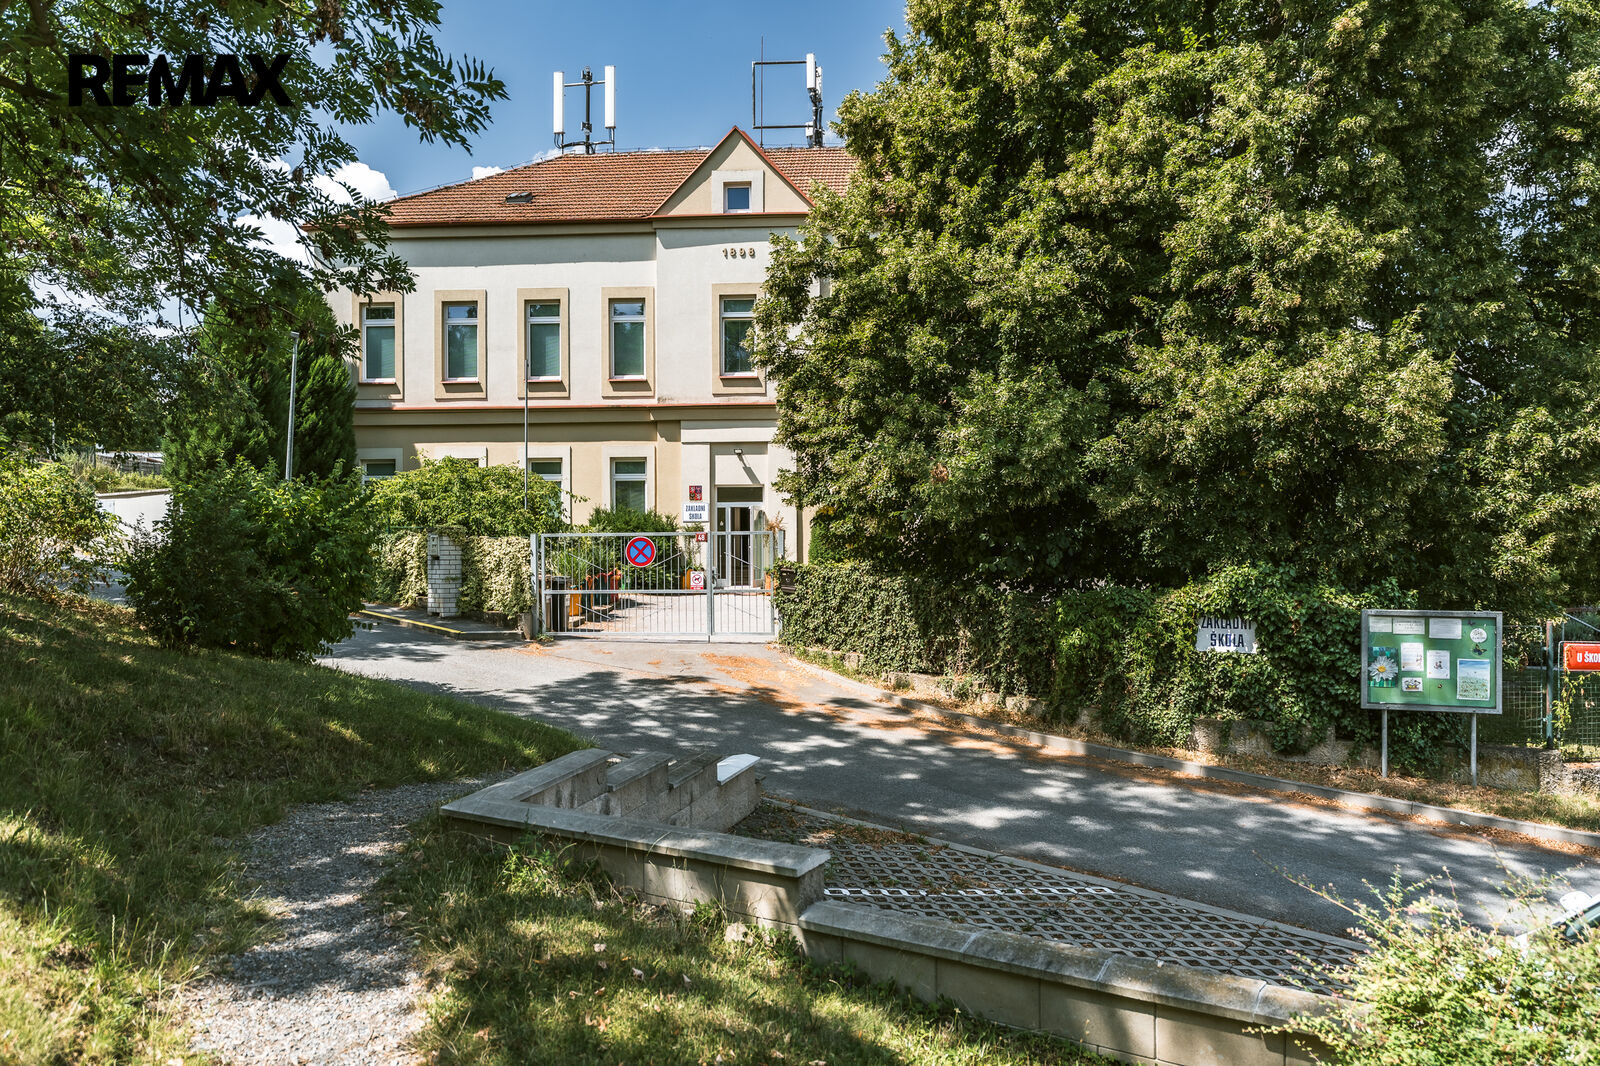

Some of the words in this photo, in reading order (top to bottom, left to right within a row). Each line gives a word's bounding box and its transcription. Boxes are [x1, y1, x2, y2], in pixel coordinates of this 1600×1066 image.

[722, 247, 755, 258] 1898
[1210, 631, 1244, 647] ŠKOLA
[1577, 652, 1583, 663] U
